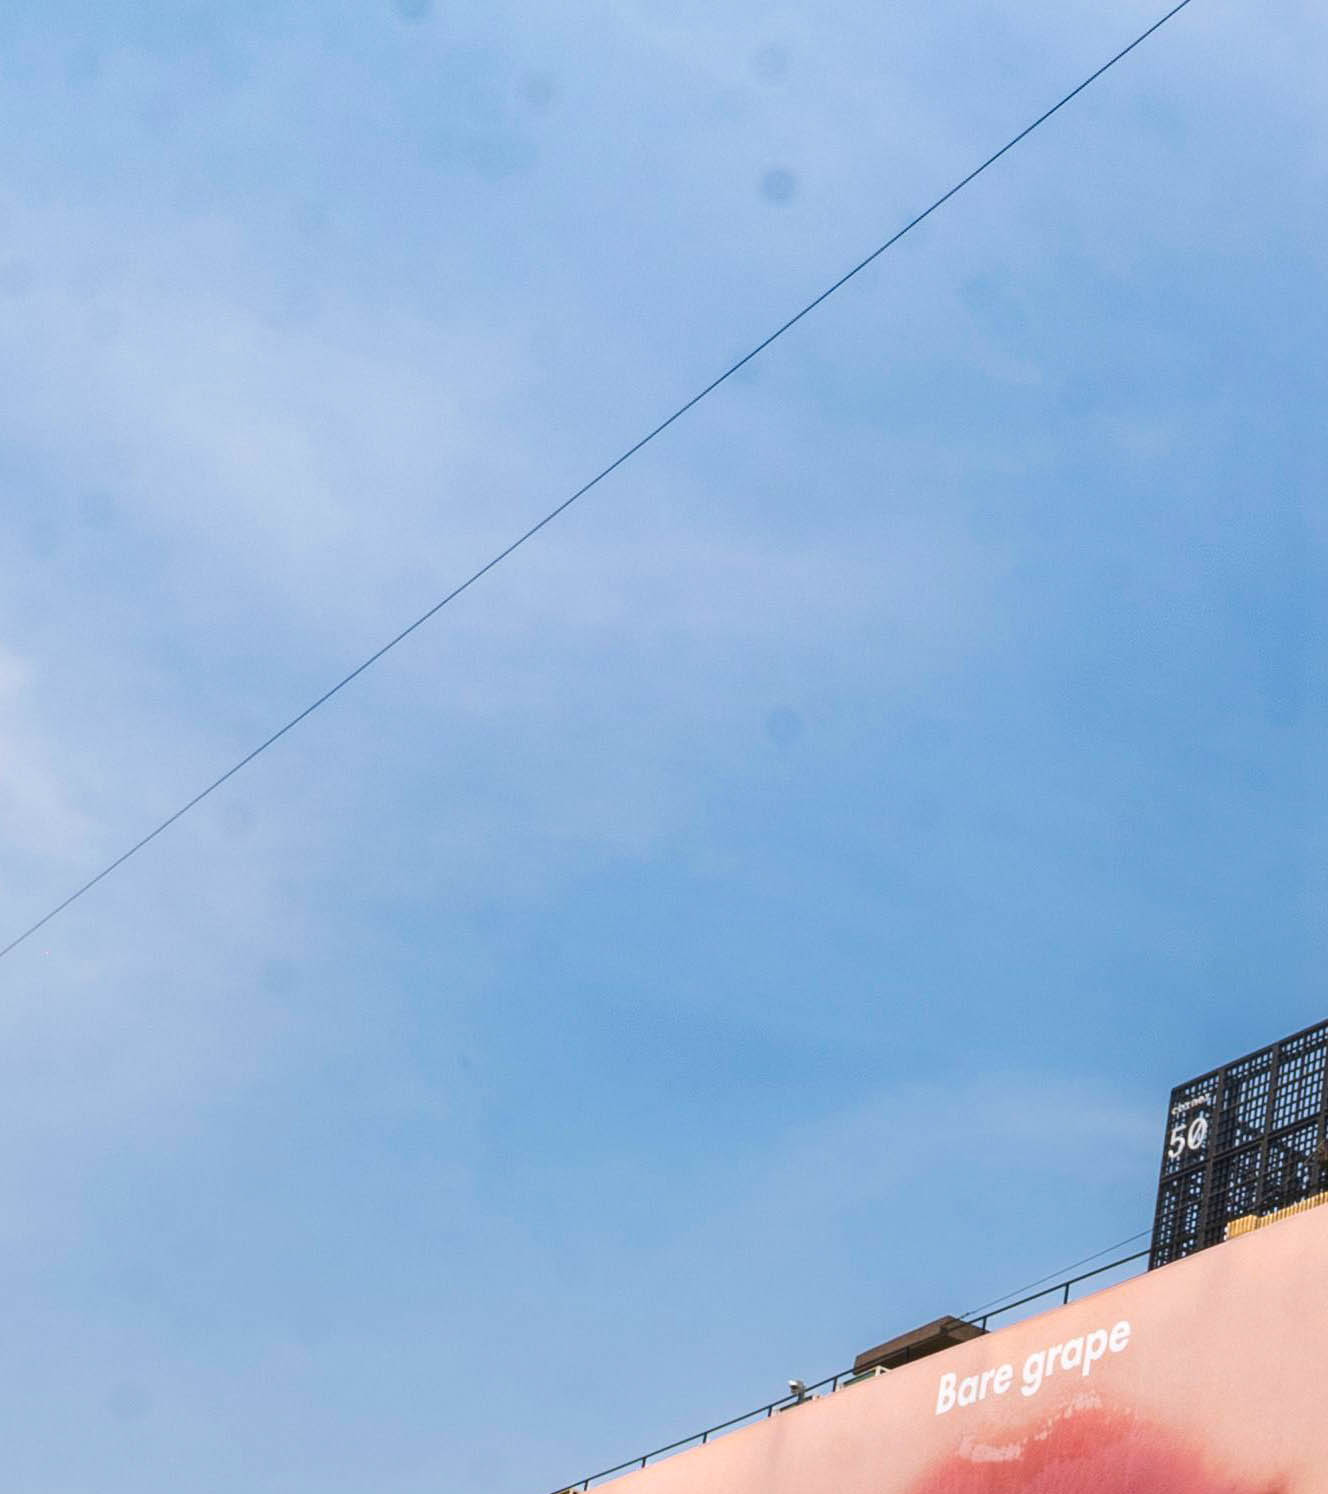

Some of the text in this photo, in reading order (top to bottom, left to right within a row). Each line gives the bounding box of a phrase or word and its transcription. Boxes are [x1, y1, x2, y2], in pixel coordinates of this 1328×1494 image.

[1168, 1117, 1208, 1158] 50
[936, 1320, 1132, 1416] Bare grape
